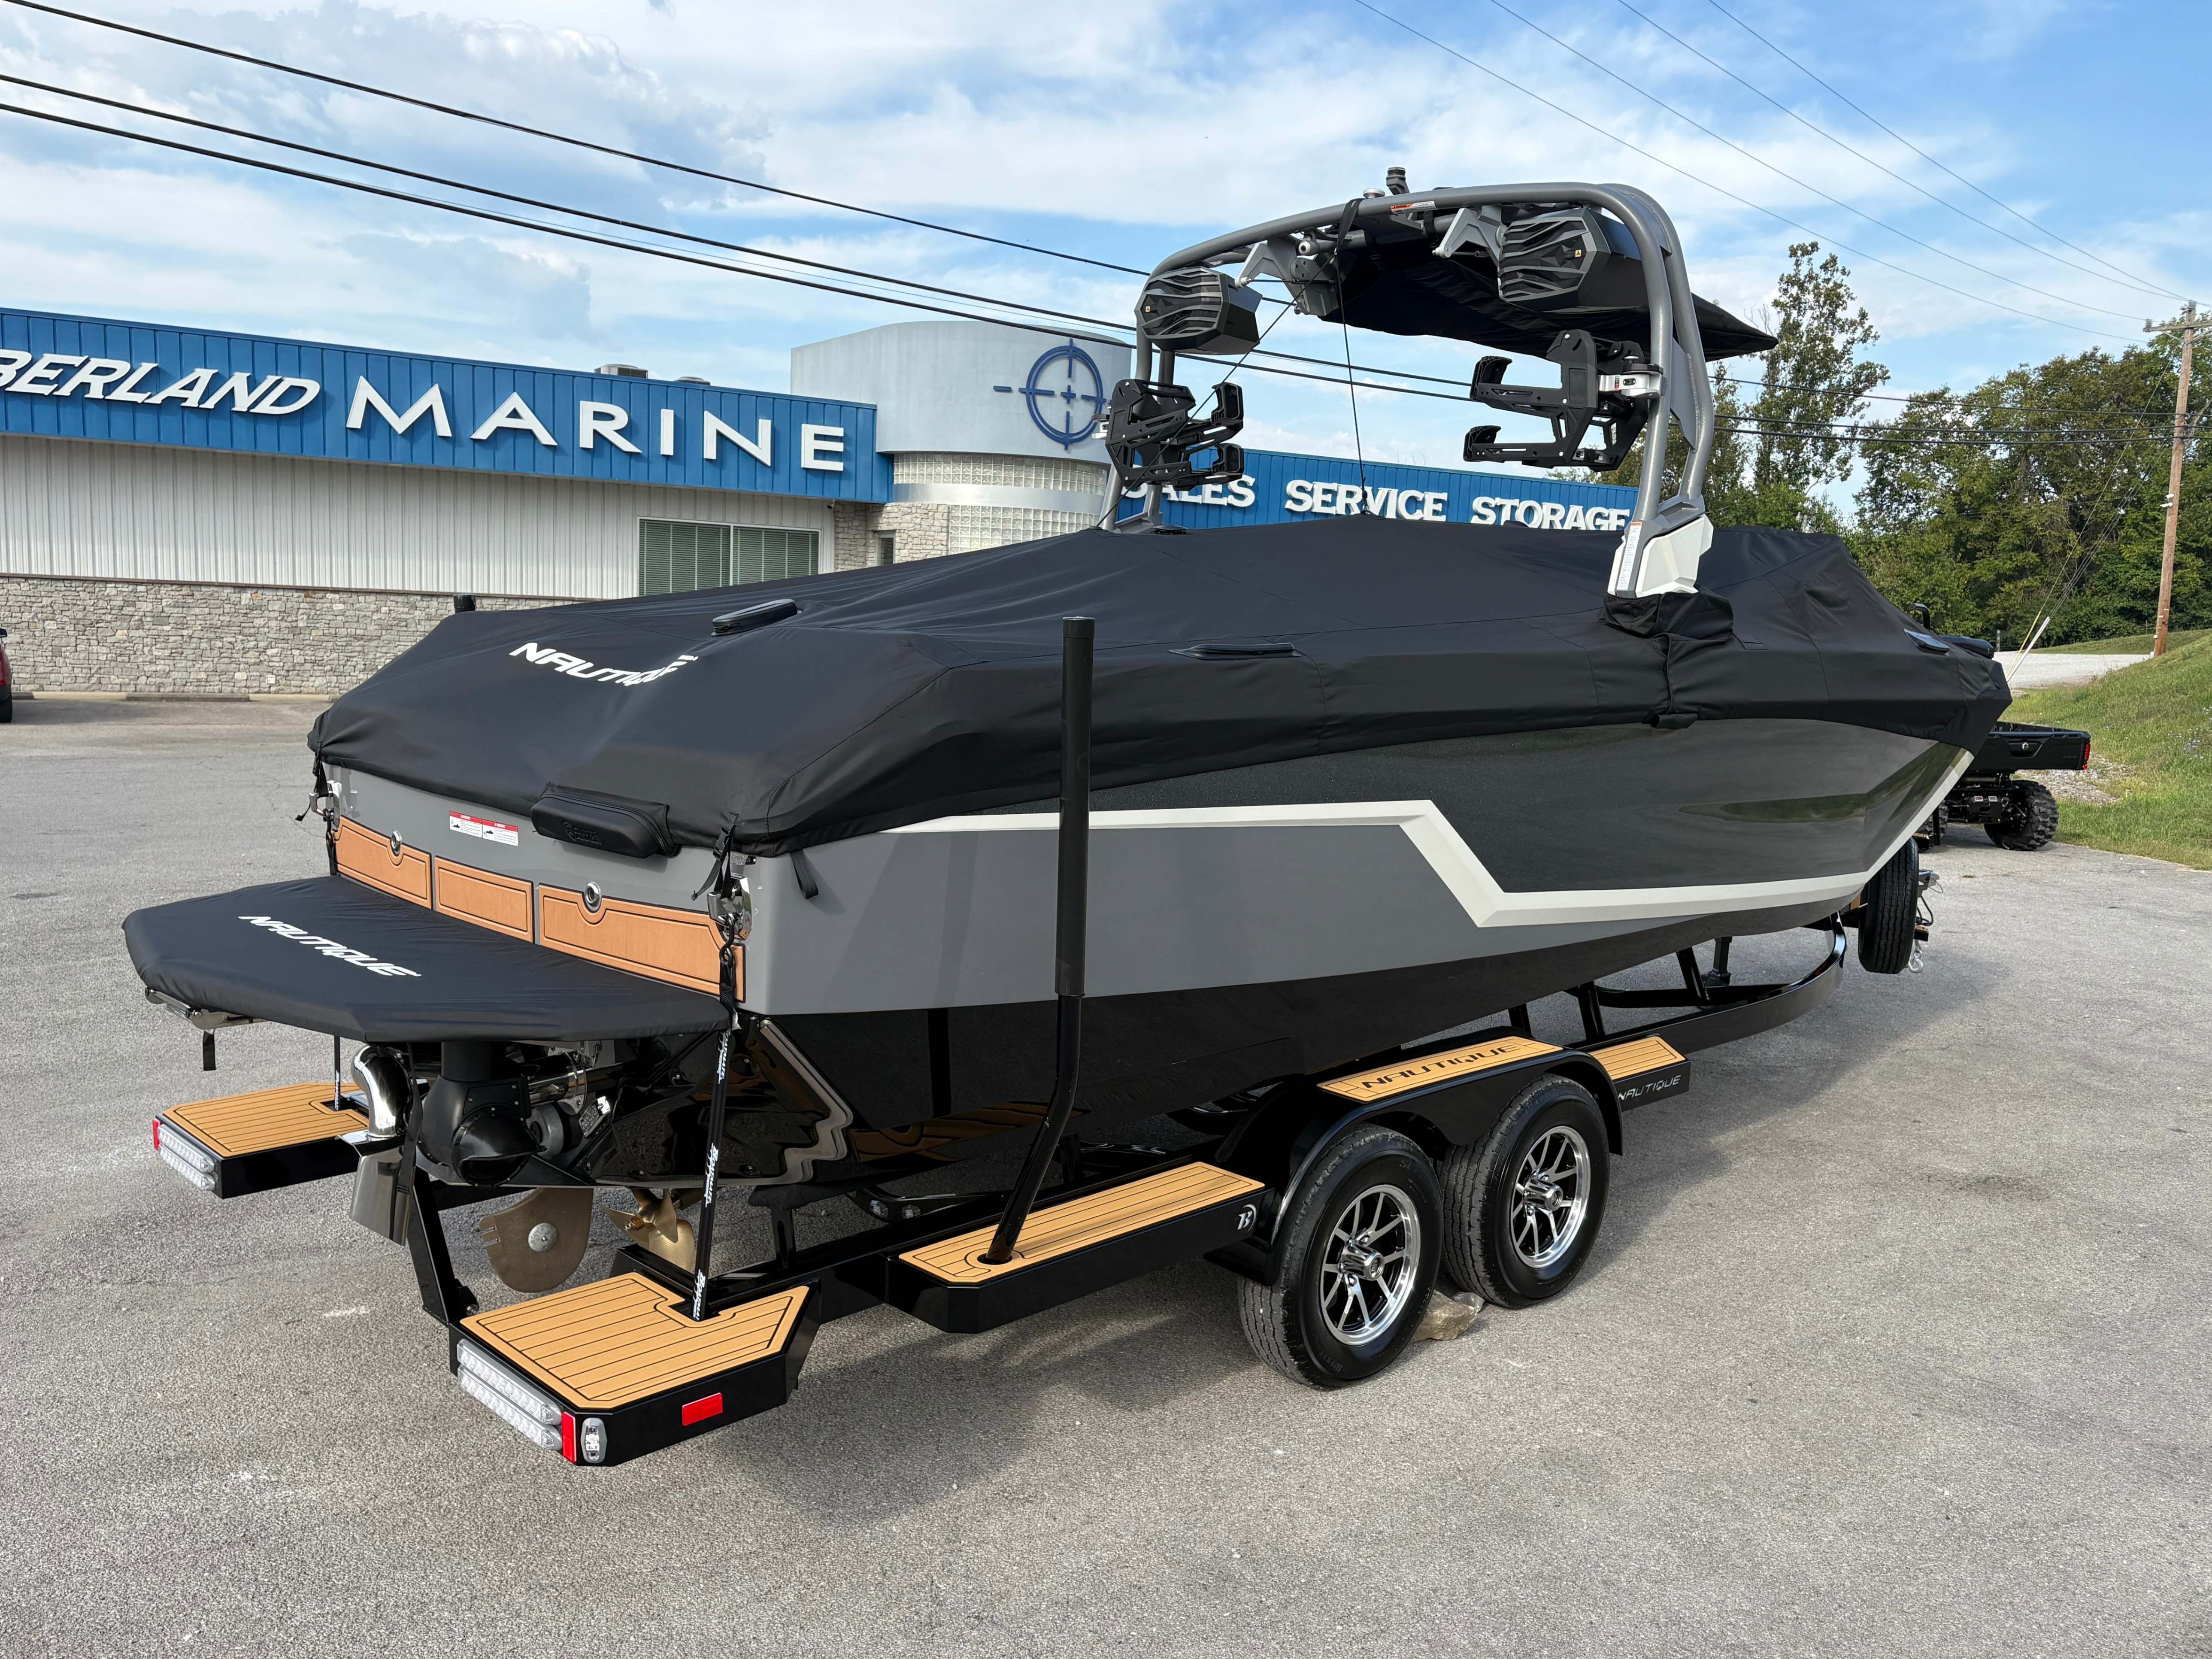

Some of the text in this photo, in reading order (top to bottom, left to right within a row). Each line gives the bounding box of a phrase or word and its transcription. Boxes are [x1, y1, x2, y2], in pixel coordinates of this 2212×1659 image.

[346, 375, 844, 471] MARINE
[1285, 479, 1448, 522] SERVICE
[1470, 496, 1630, 531] STORAGE
[238, 916, 422, 977] NAUTIQUE
[1361, 1044, 1521, 1089] NAUTIQUE
[1618, 1074, 1682, 1101] NAUTIQUE
